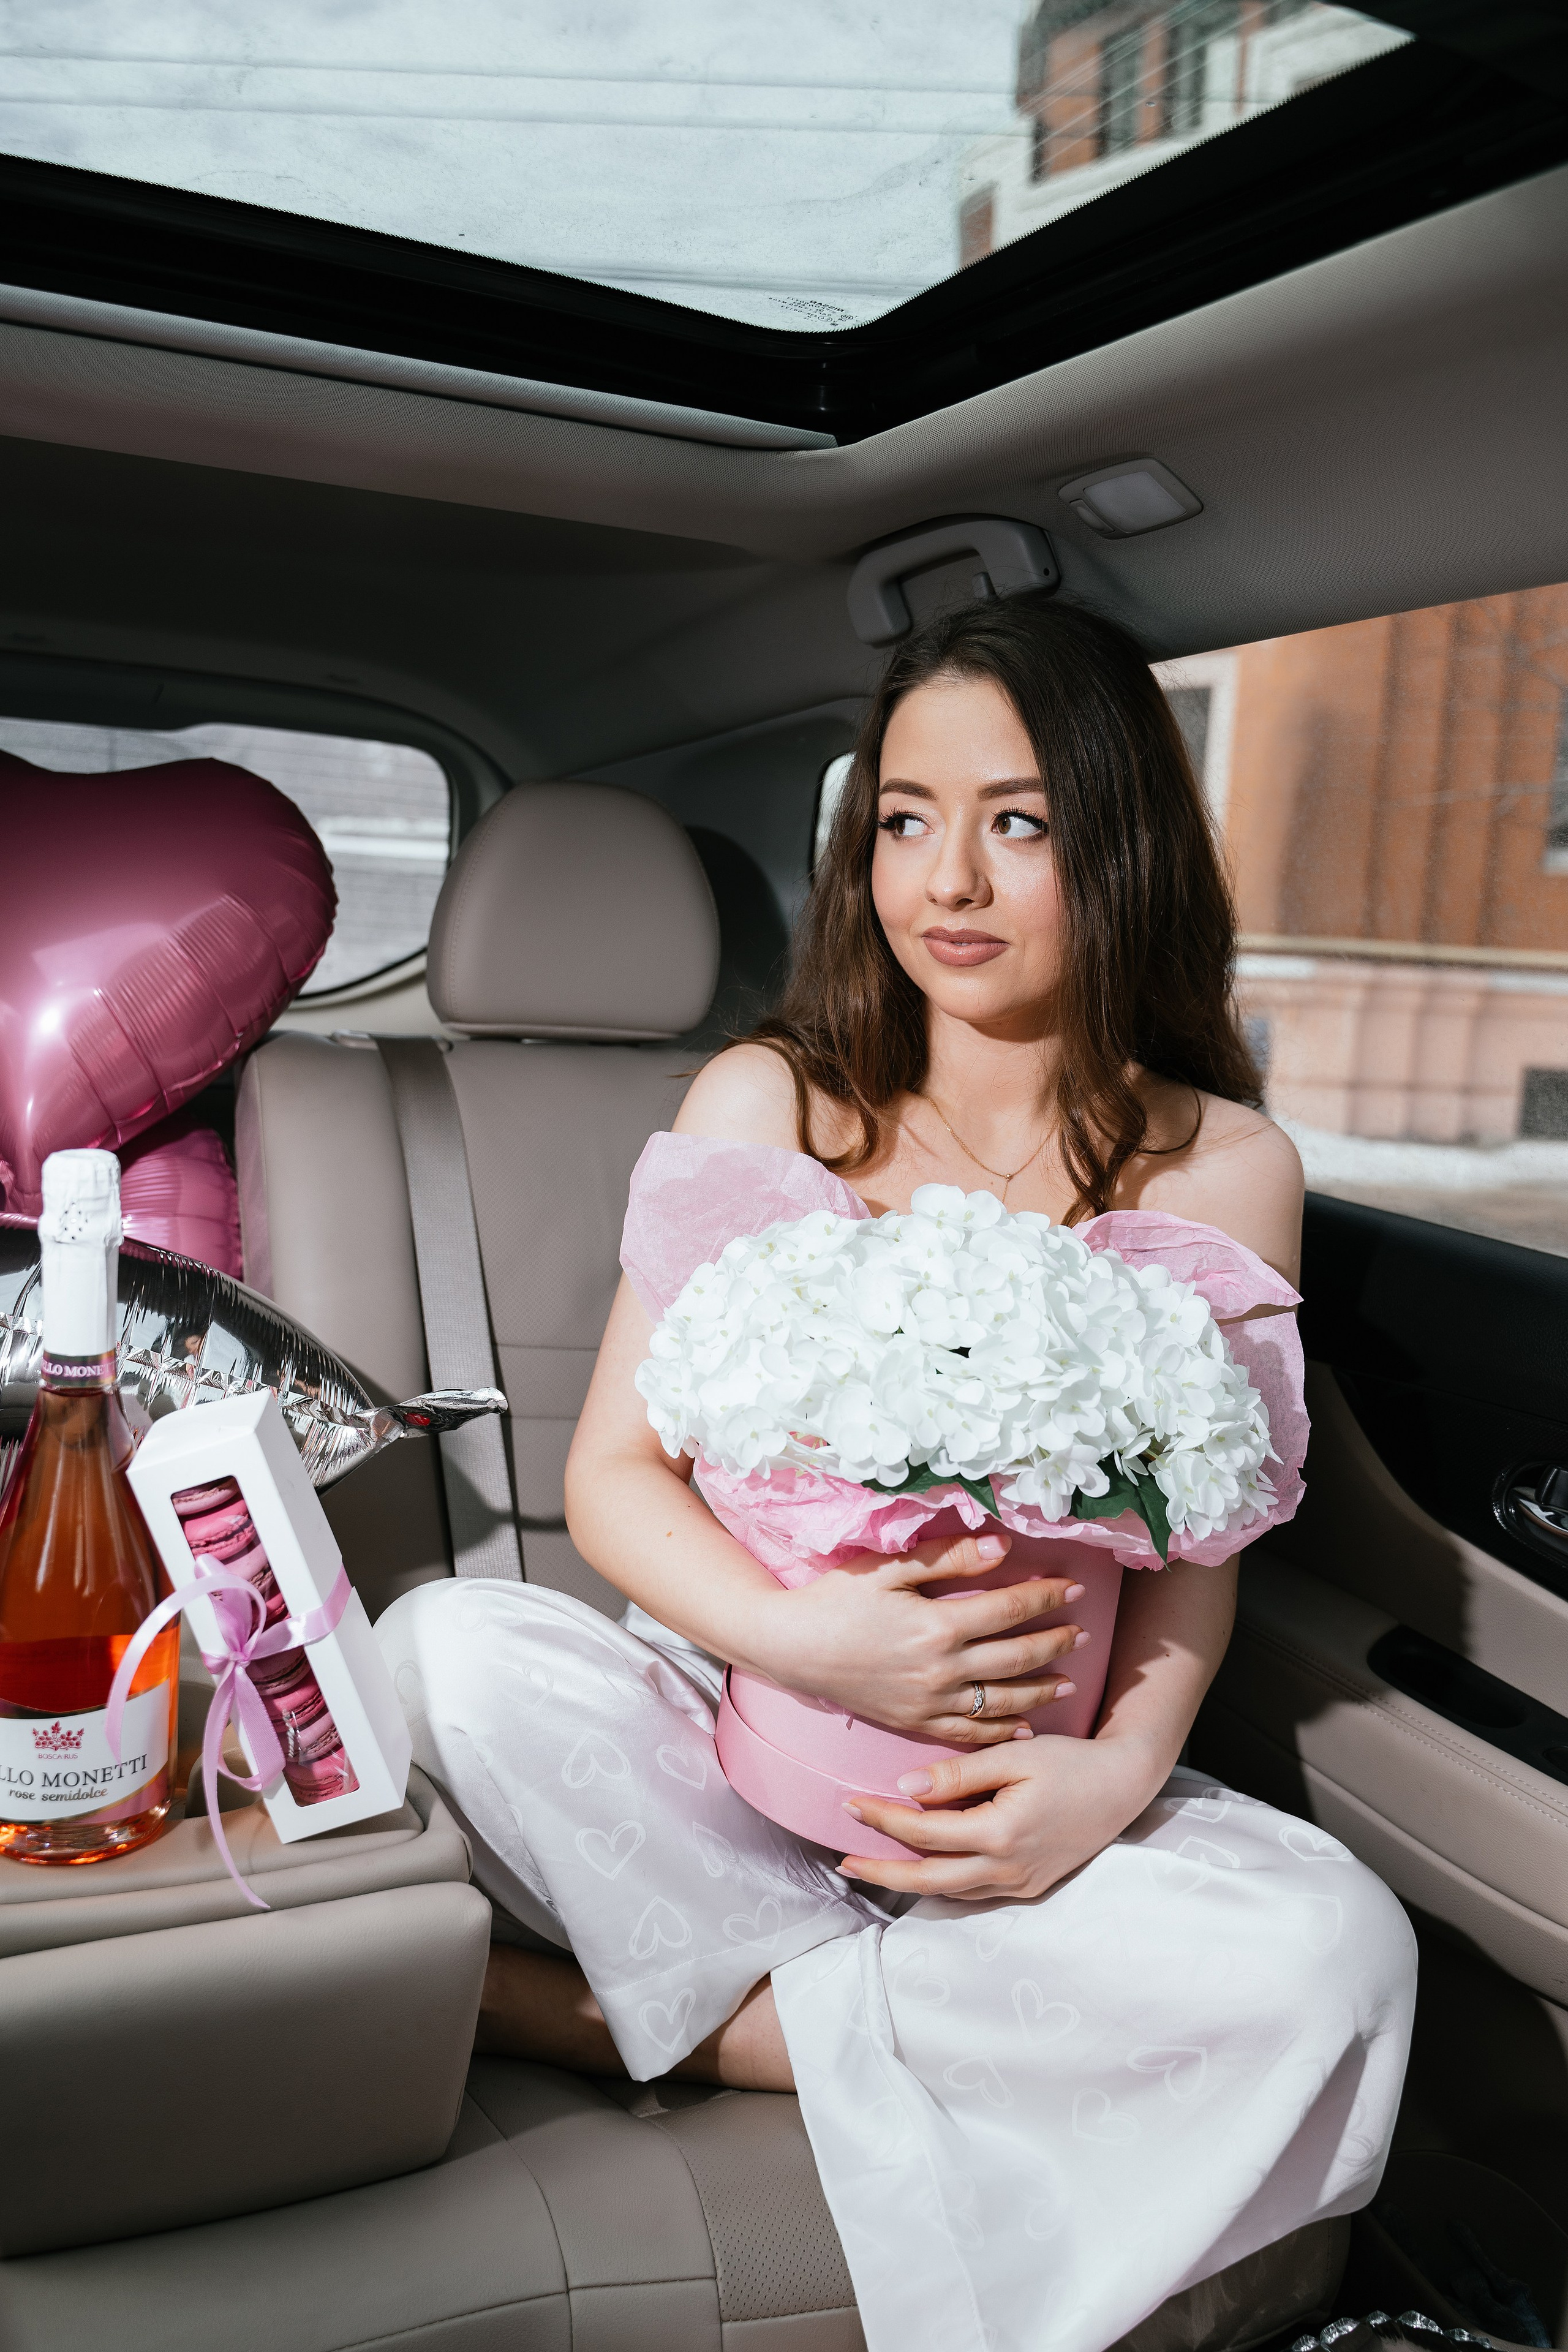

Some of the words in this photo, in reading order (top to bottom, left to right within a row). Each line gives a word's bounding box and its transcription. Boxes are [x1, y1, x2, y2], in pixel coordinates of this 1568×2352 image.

[42, 1754, 148, 1787] MONETTI
[9, 1789, 36, 1800] rose
[42, 1786, 108, 1801] semidolce
